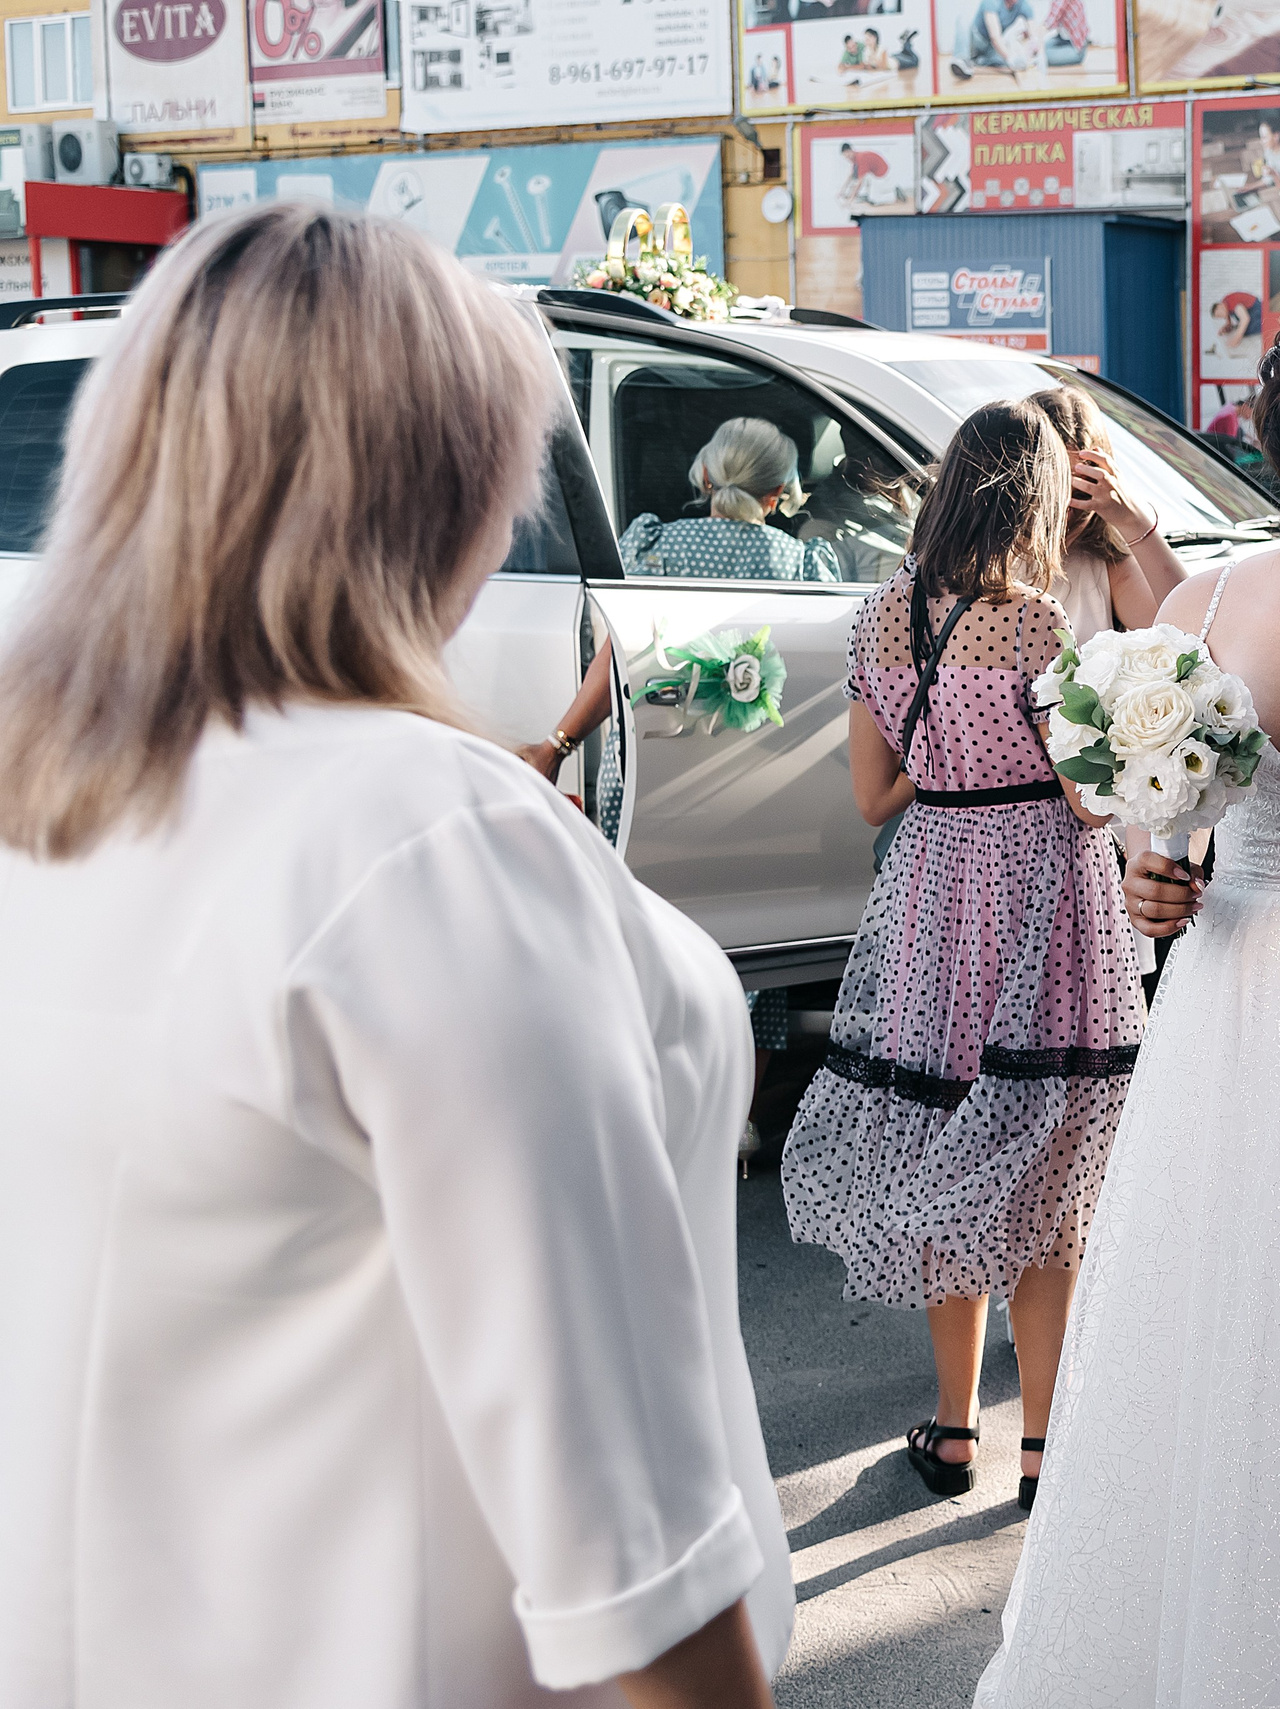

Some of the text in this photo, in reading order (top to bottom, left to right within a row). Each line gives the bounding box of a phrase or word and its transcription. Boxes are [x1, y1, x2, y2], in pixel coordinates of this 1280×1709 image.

[121, 2, 217, 44] EVITA
[549, 54, 709, 86] 8-961-697-97-17
[121, 97, 217, 123] ПАЛЬНИ
[973, 104, 1154, 135] КЕРАМИЧЕСКАЯ
[973, 141, 1067, 166] ПЛИТКА
